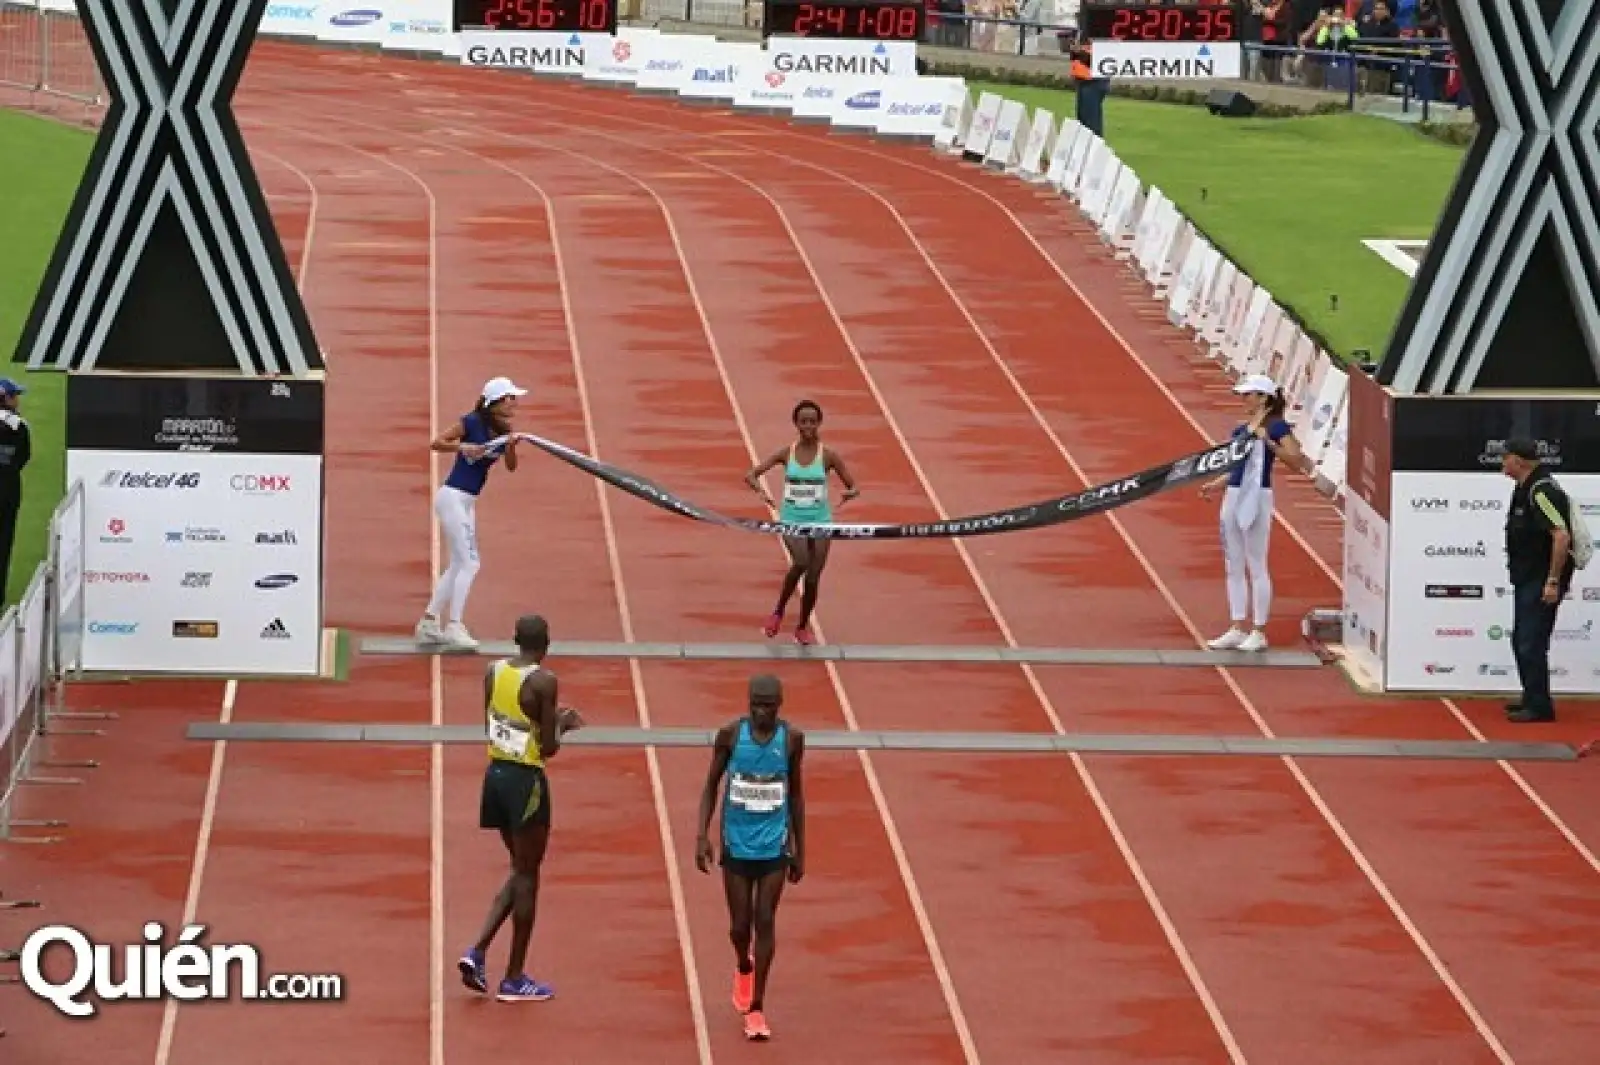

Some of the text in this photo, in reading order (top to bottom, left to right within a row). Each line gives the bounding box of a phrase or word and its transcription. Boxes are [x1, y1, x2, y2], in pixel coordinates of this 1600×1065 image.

[485, 0, 607, 30] 2:56:10
[794, 4, 916, 37] 2:41:08
[1111, 9, 1232, 40] 2:20:35
[467, 46, 586, 66] GARMIN
[774, 53, 891, 74] GARMIN
[1097, 58, 1214, 76] GARMIN
[174, 472, 201, 488] 4G
[230, 474, 291, 491] CDMX
[1424, 544, 1486, 556] GARMIN
